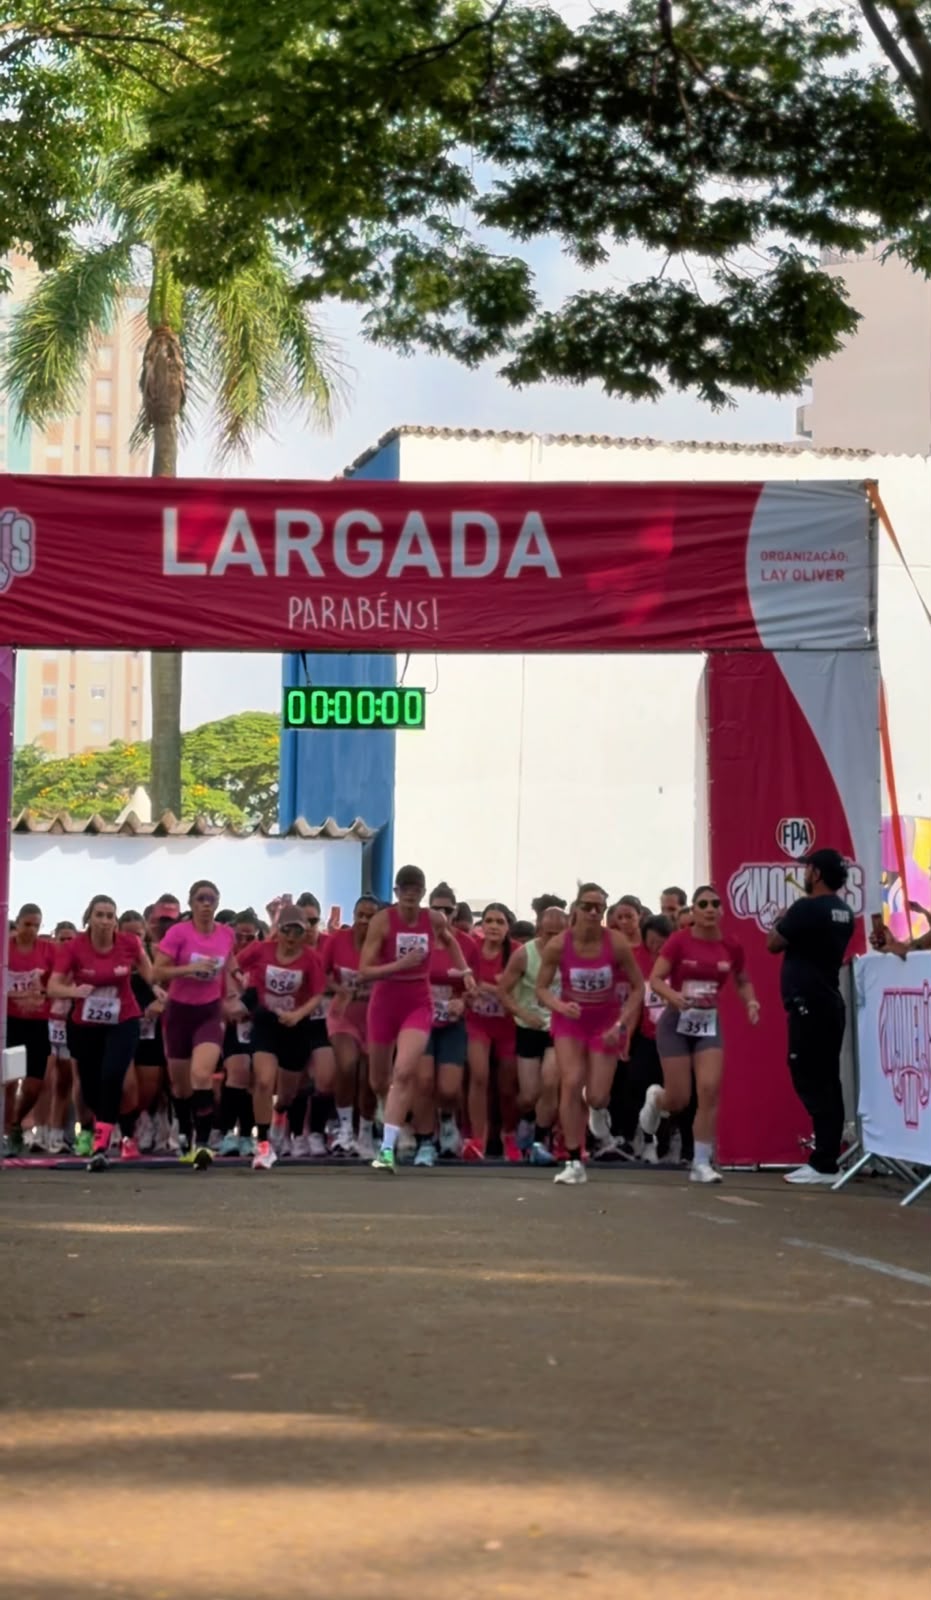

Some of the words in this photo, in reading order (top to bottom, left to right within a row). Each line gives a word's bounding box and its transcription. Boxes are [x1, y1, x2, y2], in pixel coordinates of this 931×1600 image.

[162, 507, 562, 579] LARGADA
[760, 548, 849, 562] ORGANIZAÇÃO:
[760, 568, 788, 582] LAY
[792, 567, 846, 582] OLIVER
[287, 592, 440, 631] PARABÉNS!
[287, 690, 423, 726] 00:00:00
[783, 821, 810, 851] FPA
[87, 1008, 113, 1021] 229
[685, 1021, 709, 1034] 351
